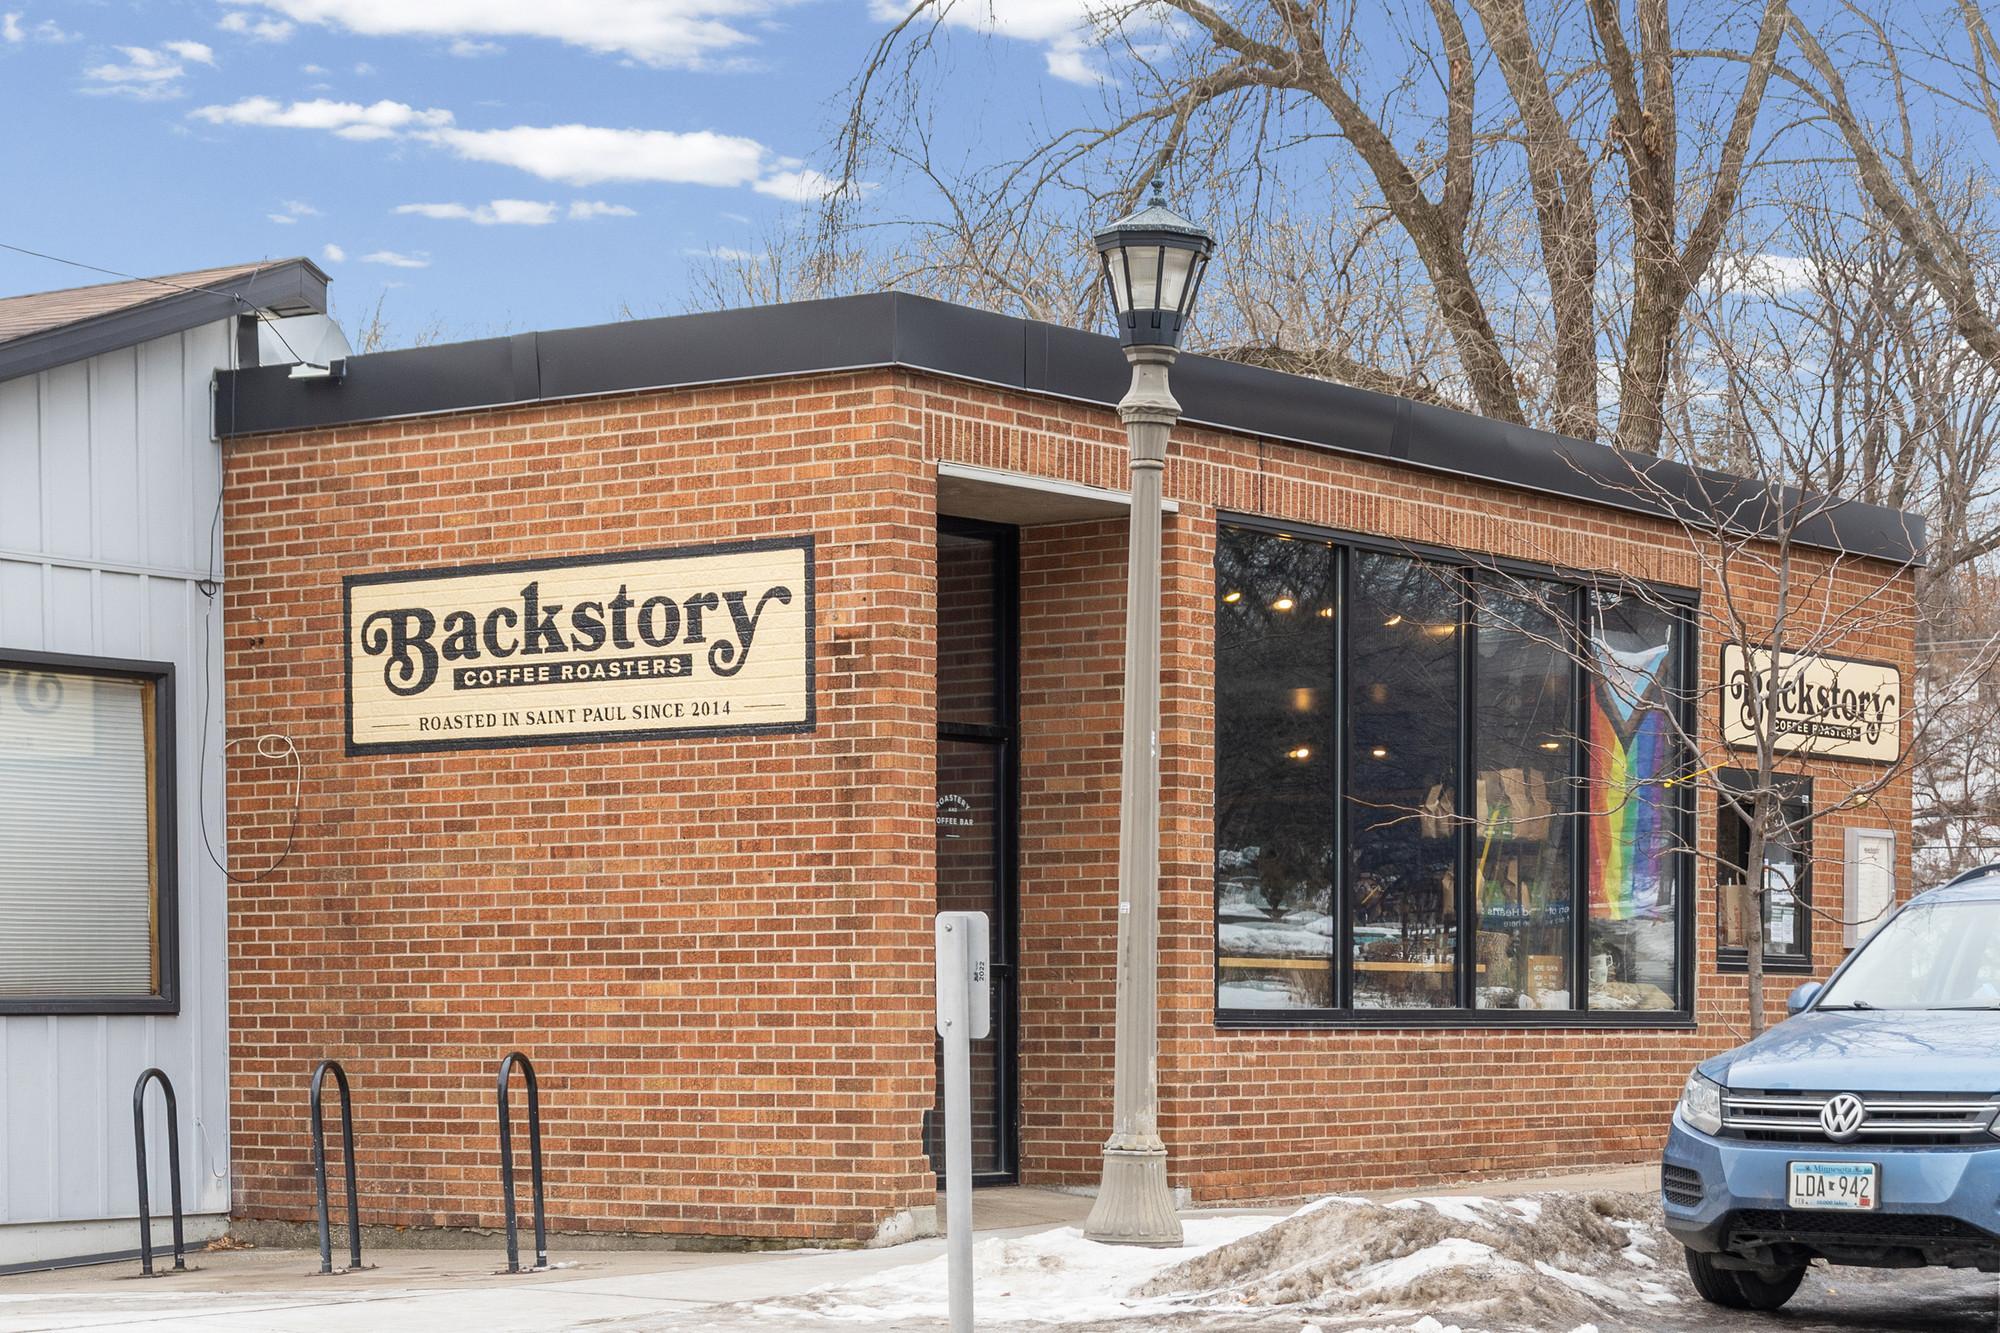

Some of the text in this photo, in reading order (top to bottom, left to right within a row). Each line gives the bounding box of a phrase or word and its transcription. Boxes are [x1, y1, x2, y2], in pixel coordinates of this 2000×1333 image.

[361, 581, 792, 696] Backstory
[463, 657, 682, 686] COFFEE ROASTERS
[419, 700, 731, 731] ROASTED IN SAINT PAUL SINCE 2014
[935, 794, 971, 811] ROASTERY
[935, 816, 974, 826] OFFEE BAR
[1823, 1096, 1860, 1135] VW
[1813, 1164, 1852, 1173] Minnesota
[1795, 1175, 1869, 1198] LDA 942
